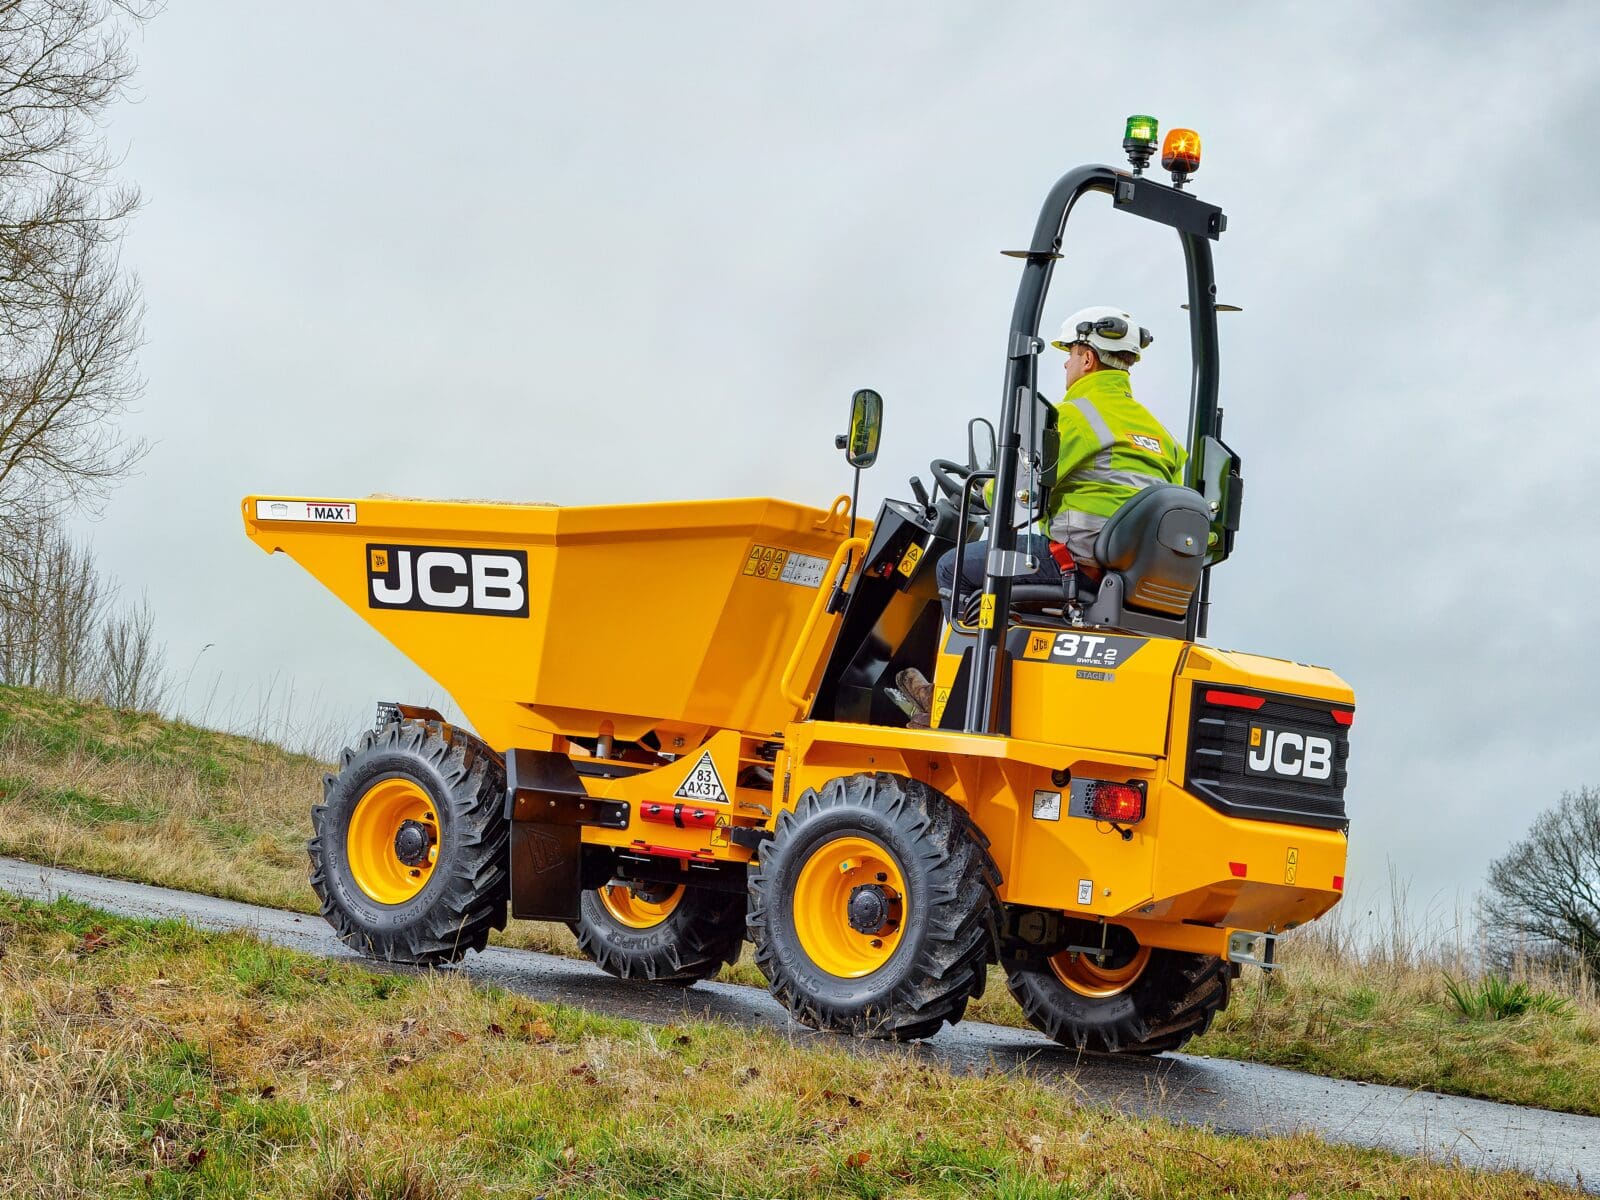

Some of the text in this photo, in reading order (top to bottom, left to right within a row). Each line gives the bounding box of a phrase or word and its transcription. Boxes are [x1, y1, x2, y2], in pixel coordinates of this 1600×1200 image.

[1133, 434, 1161, 454] JCB
[314, 507, 343, 520] MAX
[372, 551, 524, 611] JCB
[1032, 638, 1048, 651] JCB
[1076, 657, 1102, 665] SWIVEL
[1077, 671, 1104, 680] STAGE
[1249, 730, 1331, 779] JCB
[697, 769, 711, 782] 83
[688, 782, 718, 796] AX3T
[606, 929, 659, 950] DUMPER
